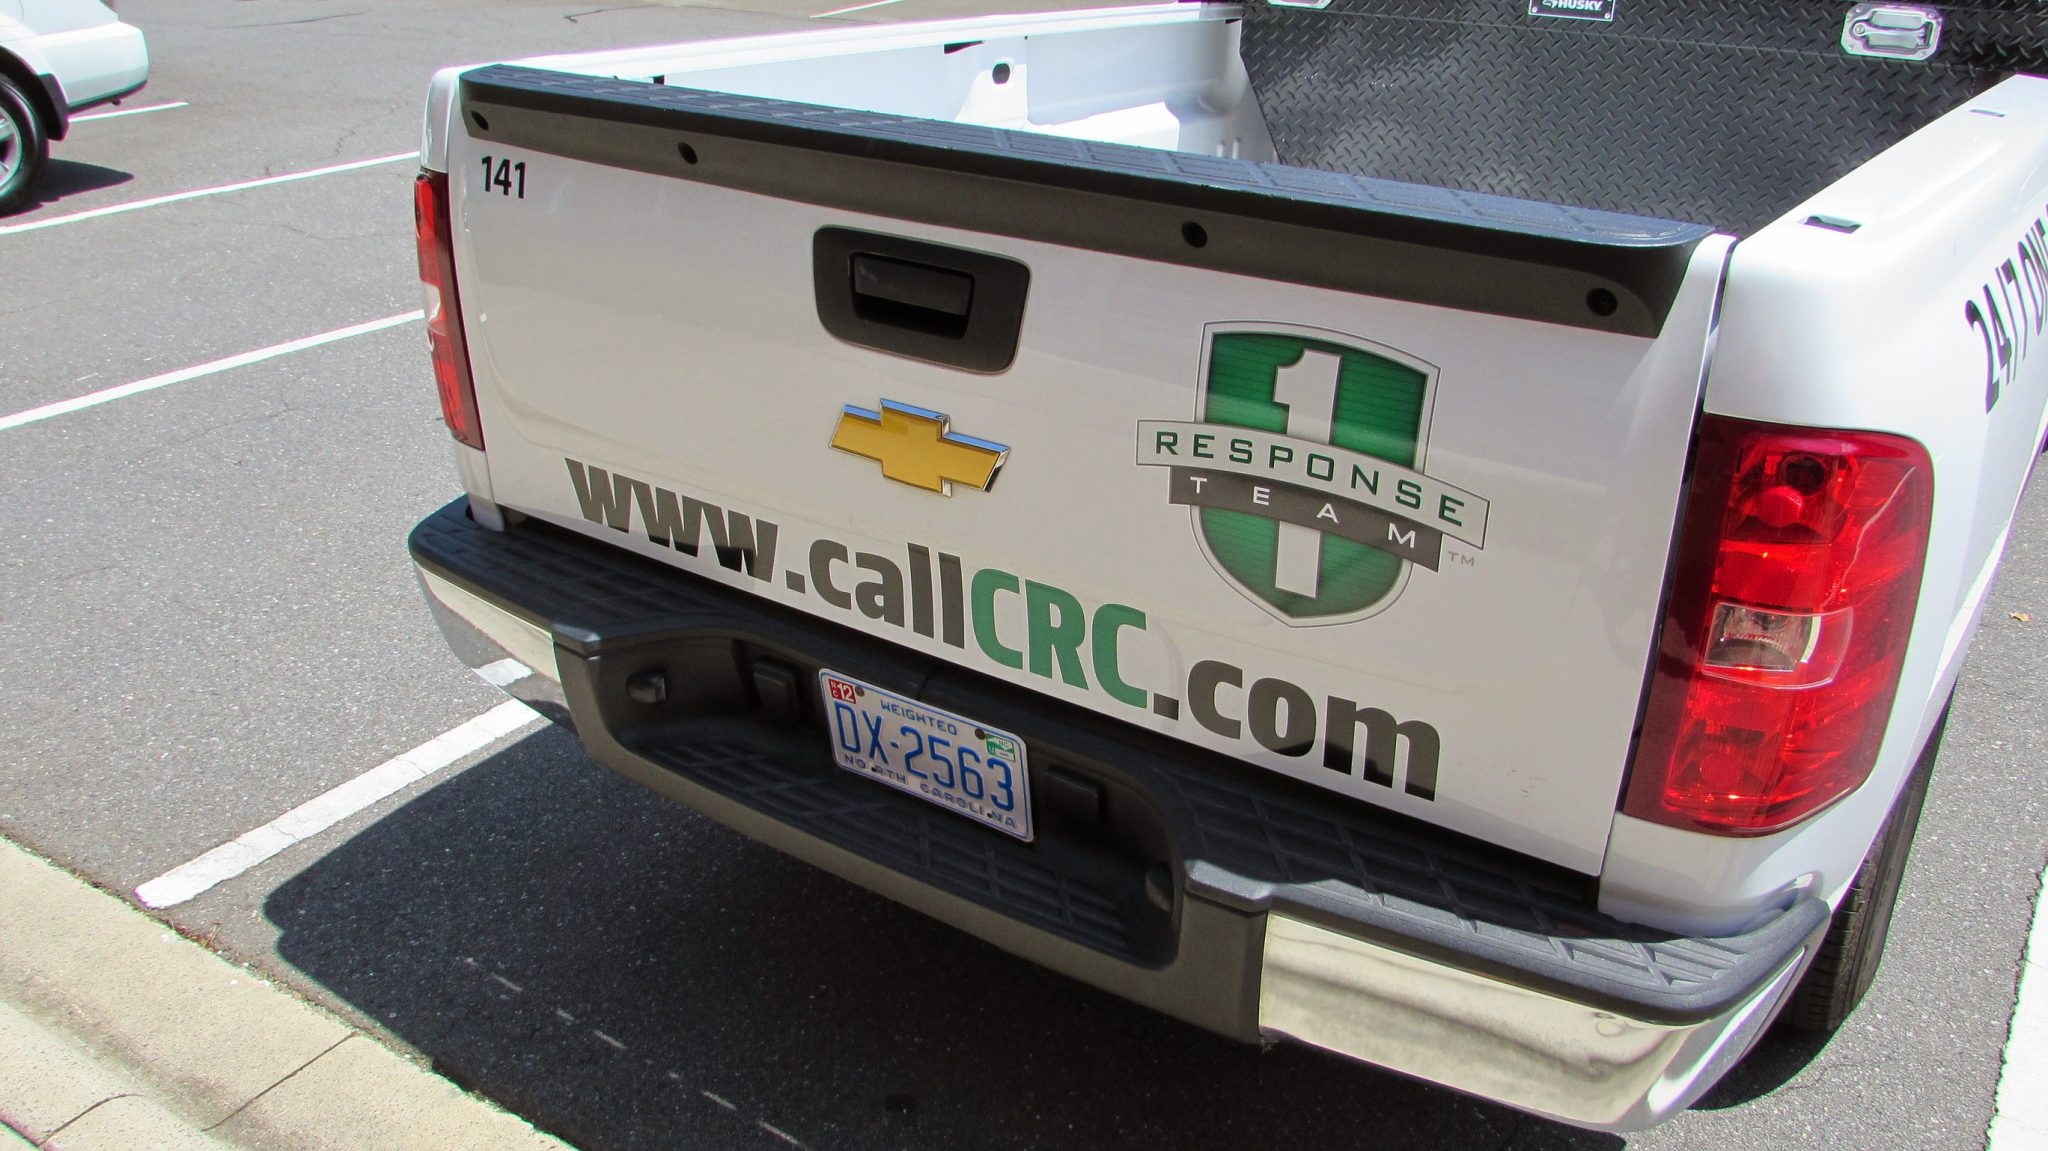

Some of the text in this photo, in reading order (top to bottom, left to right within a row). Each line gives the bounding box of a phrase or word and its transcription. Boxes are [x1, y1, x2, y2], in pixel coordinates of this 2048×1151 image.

[1558, 0, 1603, 11] HUSKY
[481, 155, 526, 199] 141
[1965, 258, 2028, 414] 24/7
[1155, 430, 1465, 527] RESPONSE
[1190, 475, 1417, 549] TEAM
[1447, 550, 1475, 567] TM
[564, 457, 1440, 802] www.callCRC.com
[837, 683, 855, 702] 12
[880, 699, 957, 735] WEIGHTED
[834, 701, 1015, 812] DX-2563
[844, 755, 1017, 829] NORTH CAROLINA
